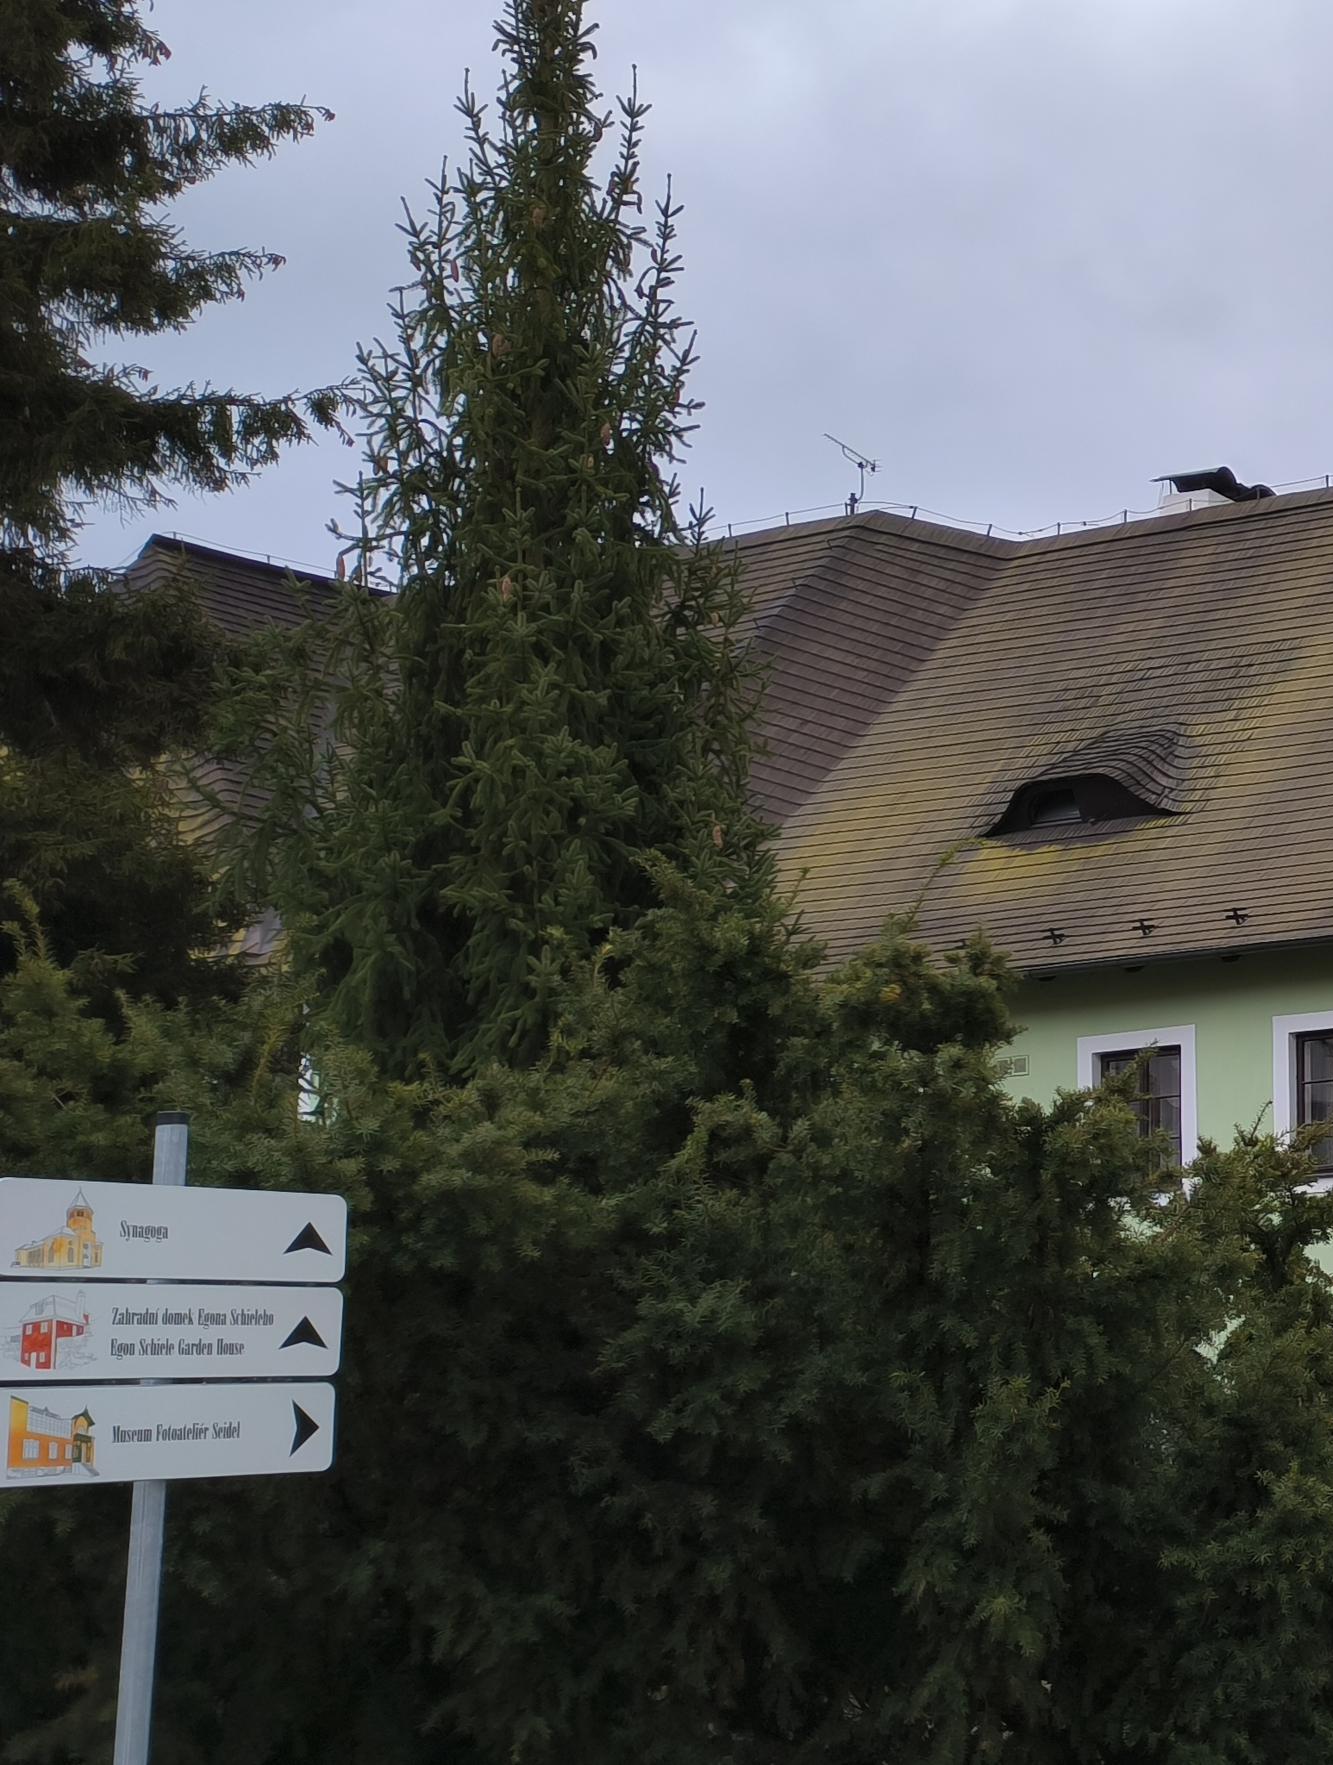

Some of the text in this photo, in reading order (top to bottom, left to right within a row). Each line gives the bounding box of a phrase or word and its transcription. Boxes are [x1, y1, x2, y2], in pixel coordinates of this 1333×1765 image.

[119, 1219, 169, 1243] Synagoga
[111, 1306, 274, 1329] Zahradní domek Egona Schieleho
[110, 1338, 245, 1360] Egon Schiele Garden House
[112, 1421, 241, 1444] Museum Fotoateliér Seidel
